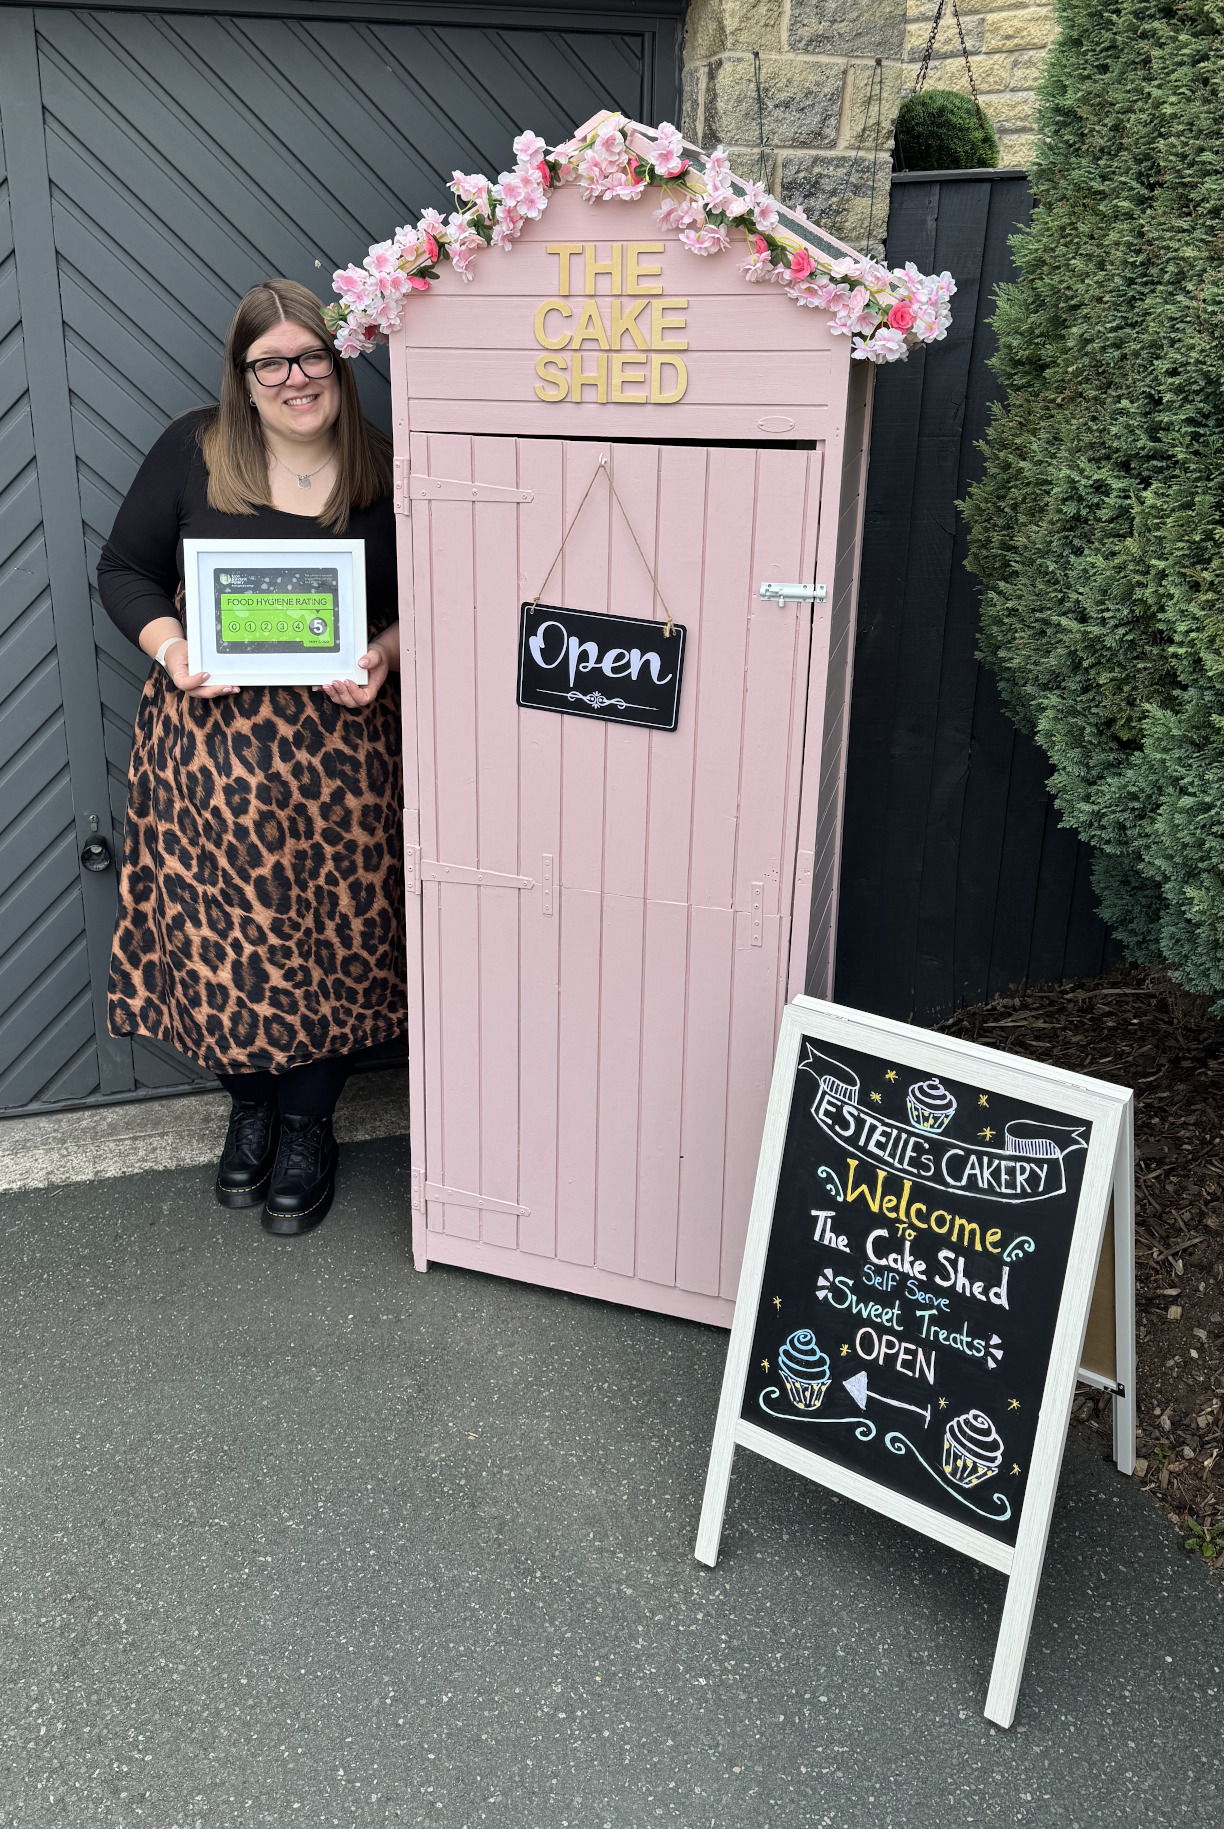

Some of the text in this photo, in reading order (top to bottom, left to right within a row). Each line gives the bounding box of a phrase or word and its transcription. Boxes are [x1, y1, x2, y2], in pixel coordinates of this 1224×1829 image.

[546, 242, 665, 296] THE
[533, 299, 689, 350] CAKE
[533, 353, 689, 404] SHED
[227, 598, 327, 606] FOOD HYGIENE RATING
[313, 620, 324, 634] 5
[529, 621, 673, 688] Open
[941, 1149, 1048, 1194] CAKERY
[846, 1158, 1002, 1253] Welcome
[810, 1209, 1010, 1310] The Cake Shed
[827, 1276, 986, 1358] Sweet Treats
[905, 1279, 950, 1312] Serve
[855, 1327, 936, 1386] OPEN
